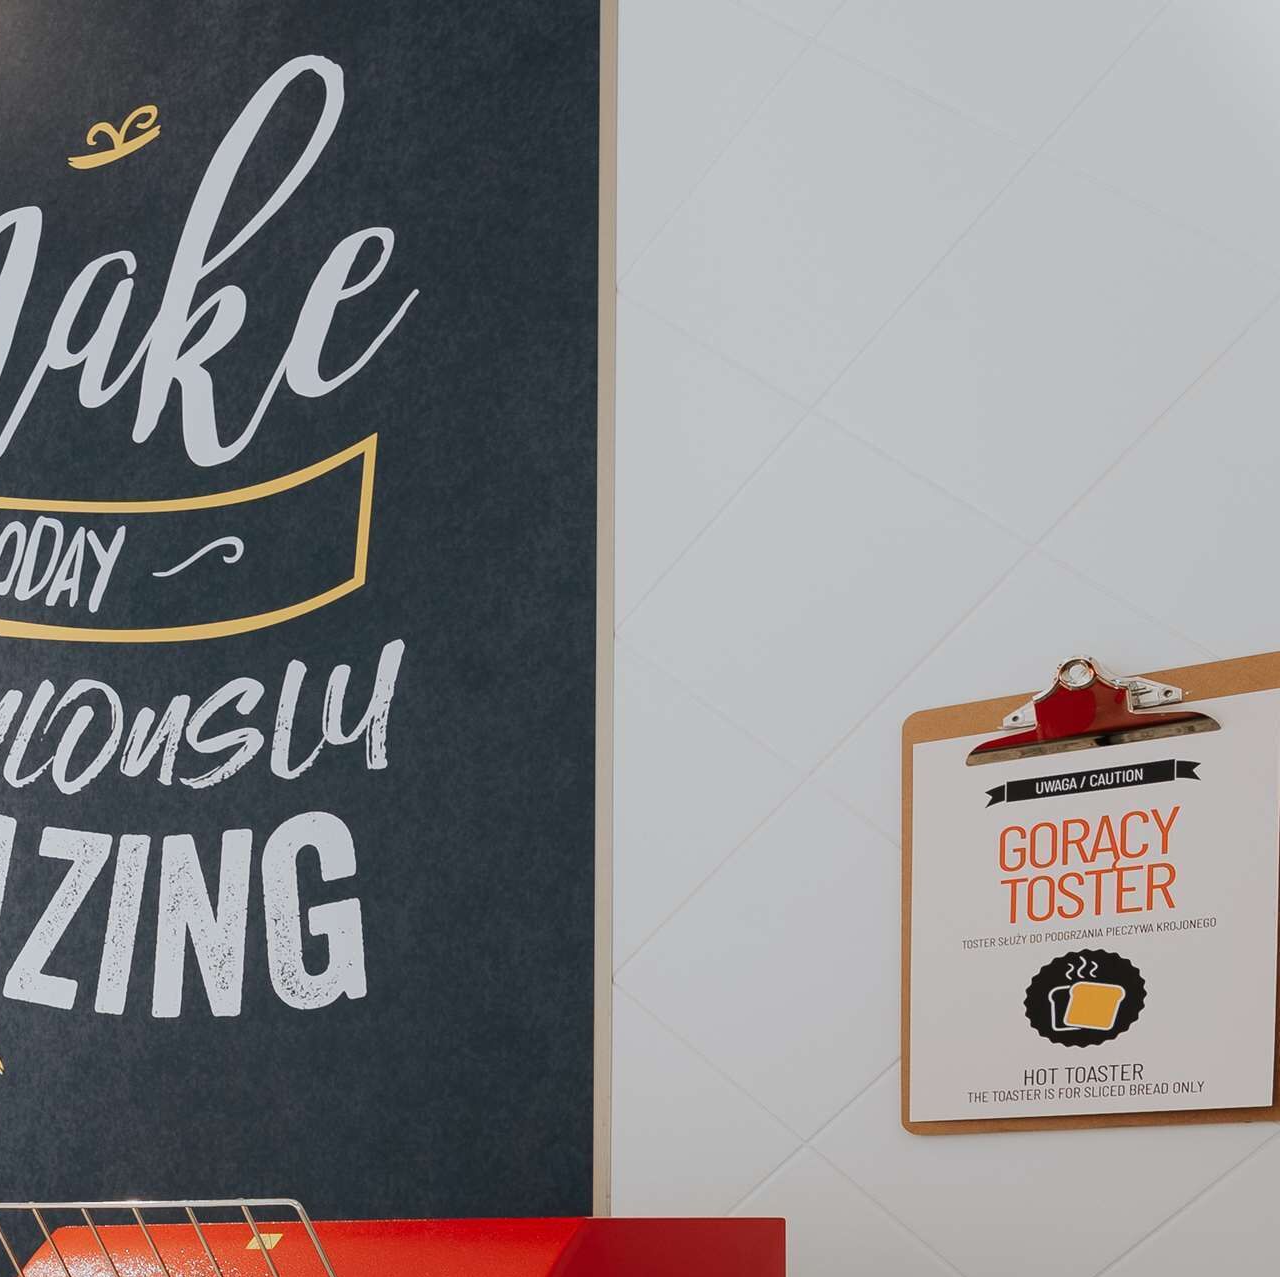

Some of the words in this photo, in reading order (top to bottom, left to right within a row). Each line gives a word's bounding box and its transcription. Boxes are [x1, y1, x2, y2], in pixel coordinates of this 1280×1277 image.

[1035, 778, 1078, 795] UWAGA
[1089, 768, 1144, 787] CAUTION
[999, 805, 1181, 872] GORĄCY
[1000, 862, 1176, 924] TOSTER
[962, 938, 996, 950] TOSTER
[998, 934, 1027, 947] SŁUŻY
[1029, 934, 1042, 944] DO
[1045, 929, 1103, 942] PODGRZANIA
[1106, 923, 1154, 937] PIECZYWA
[1156, 917, 1217, 933] KROJONEGO
[1023, 1067, 1059, 1086] HOT
[1065, 1063, 1144, 1085] TOASTER
[968, 1091, 989, 1103] THE
[992, 1089, 1041, 1102] TOASTER
[1044, 1088, 1055, 1100] IS
[1058, 1087, 1082, 1099] FOR
[1084, 1084, 1126, 1098] SLICED
[1129, 1082, 1169, 1096] BREAD
[1172, 1080, 1205, 1094] ONLY
